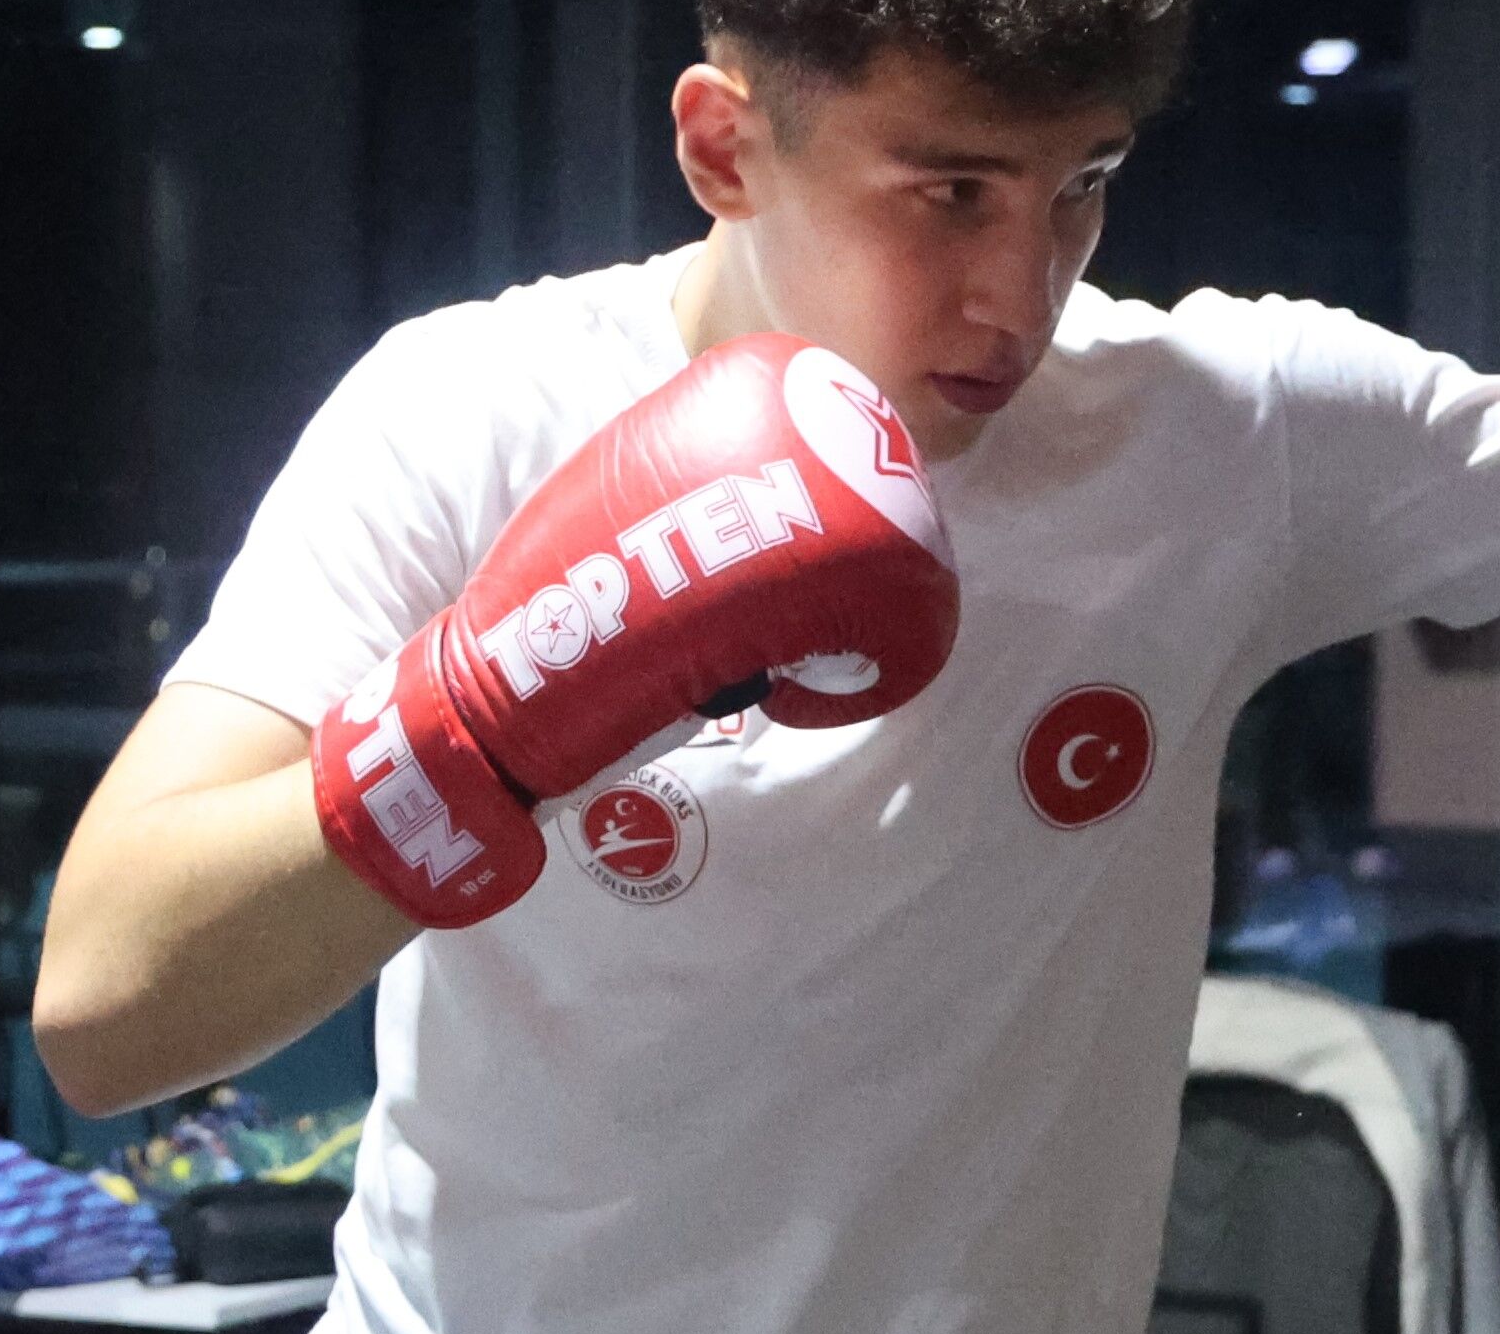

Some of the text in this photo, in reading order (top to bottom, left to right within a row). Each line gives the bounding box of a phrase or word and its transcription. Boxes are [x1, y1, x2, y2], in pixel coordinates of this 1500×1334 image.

[477, 553, 631, 701] TOP
[616, 459, 825, 600] TEN
[346, 702, 487, 889] TEN
[460, 880, 478, 897] 10
